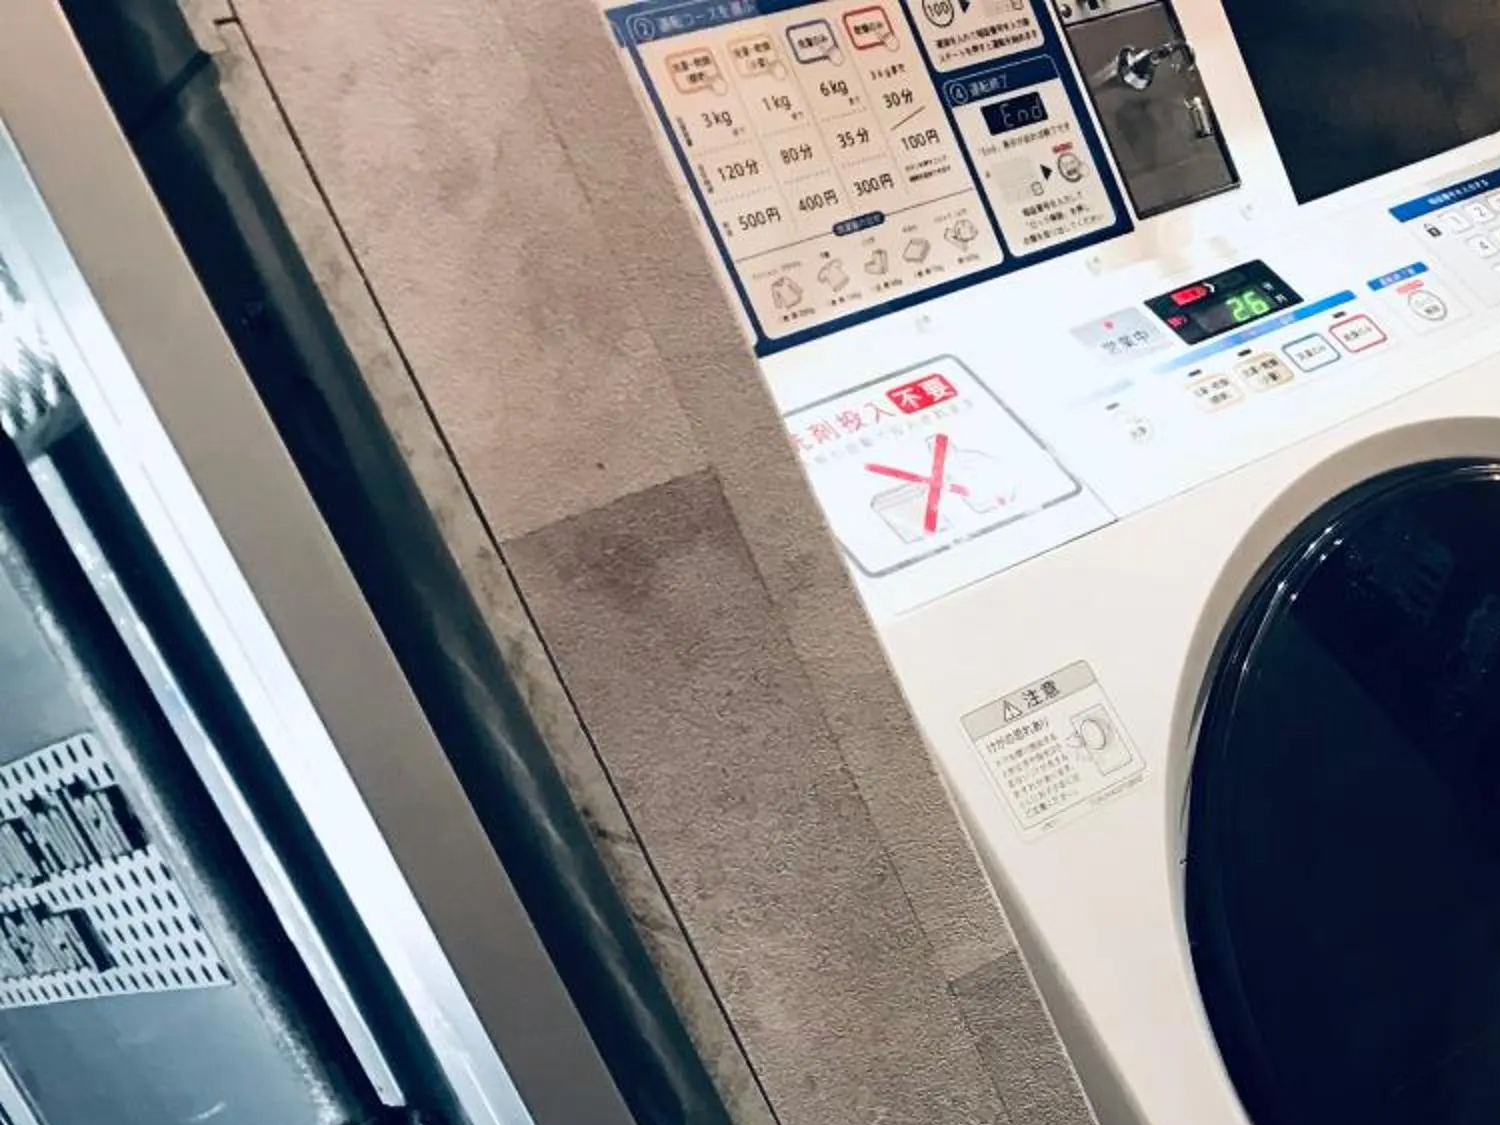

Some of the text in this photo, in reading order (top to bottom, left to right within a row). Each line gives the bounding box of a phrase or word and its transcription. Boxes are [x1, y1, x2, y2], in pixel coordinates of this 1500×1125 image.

[820, 79, 848, 97] 6kg
[882, 88, 913, 108] 30分
[762, 95, 792, 111] 1kg
[701, 111, 733, 128] 3kg
[836, 127, 870, 149] 35分
[901, 128, 941, 151] 100円
[780, 144, 813, 164] 80分
[718, 159, 759, 181] 120分
[853, 172, 895, 197] 300円
[798, 189, 839, 212] 400円
[738, 207, 782, 231] 500円
[1226, 291, 1270, 322] 26
[891, 376, 955, 410] 不要
[1022, 680, 1060, 708] 注意
